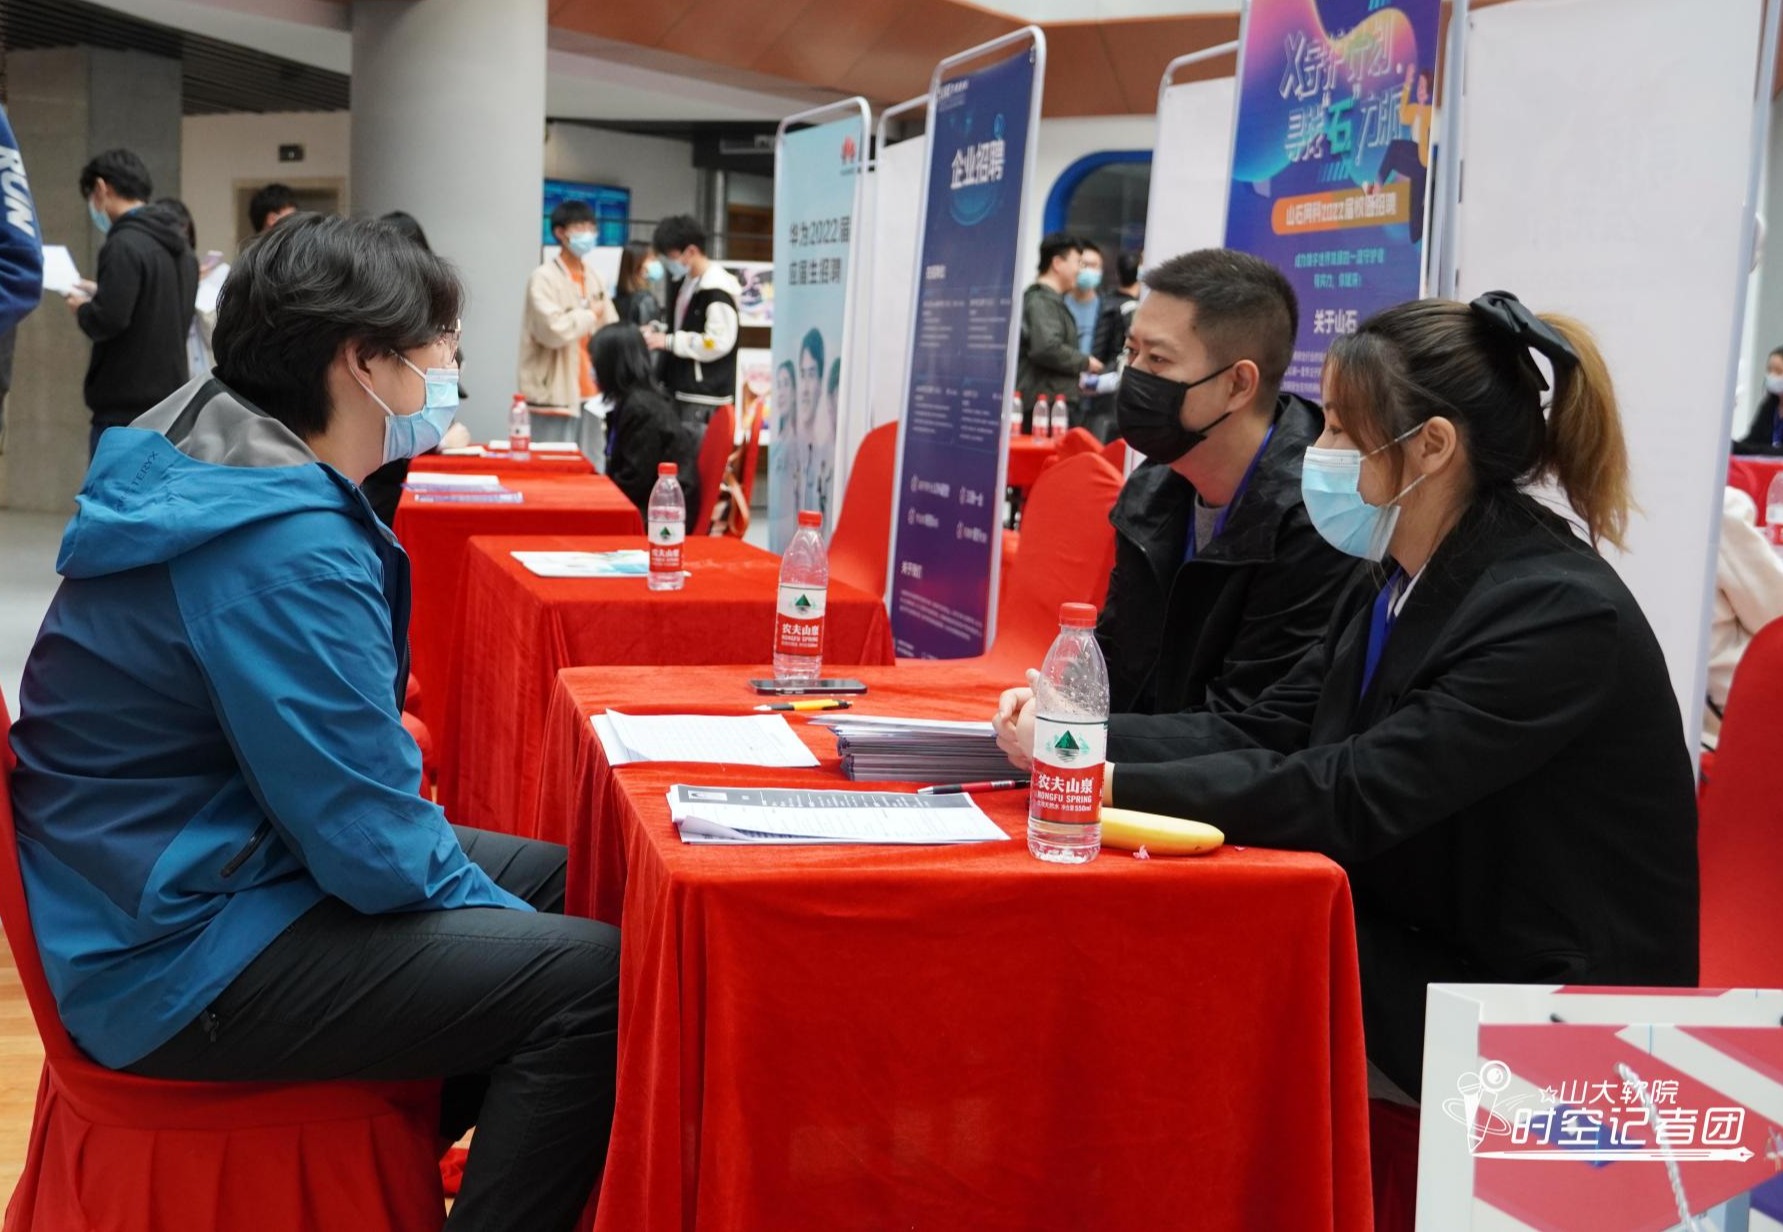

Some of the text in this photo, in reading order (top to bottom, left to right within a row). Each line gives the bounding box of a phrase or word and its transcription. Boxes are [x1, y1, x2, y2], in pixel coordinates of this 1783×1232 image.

[951, 139, 1005, 189] 企业招聘
[0, 145, 36, 237] RUN
[789, 216, 851, 247] 华为2022届
[789, 258, 841, 286] 应届生招聘
[1313, 309, 1358, 334] 关于山石
[782, 623, 820, 637] 农夫山泉
[1037, 774, 1093, 794] 农夫山泉
[1037, 790, 1092, 804] NONGFU SPRING
